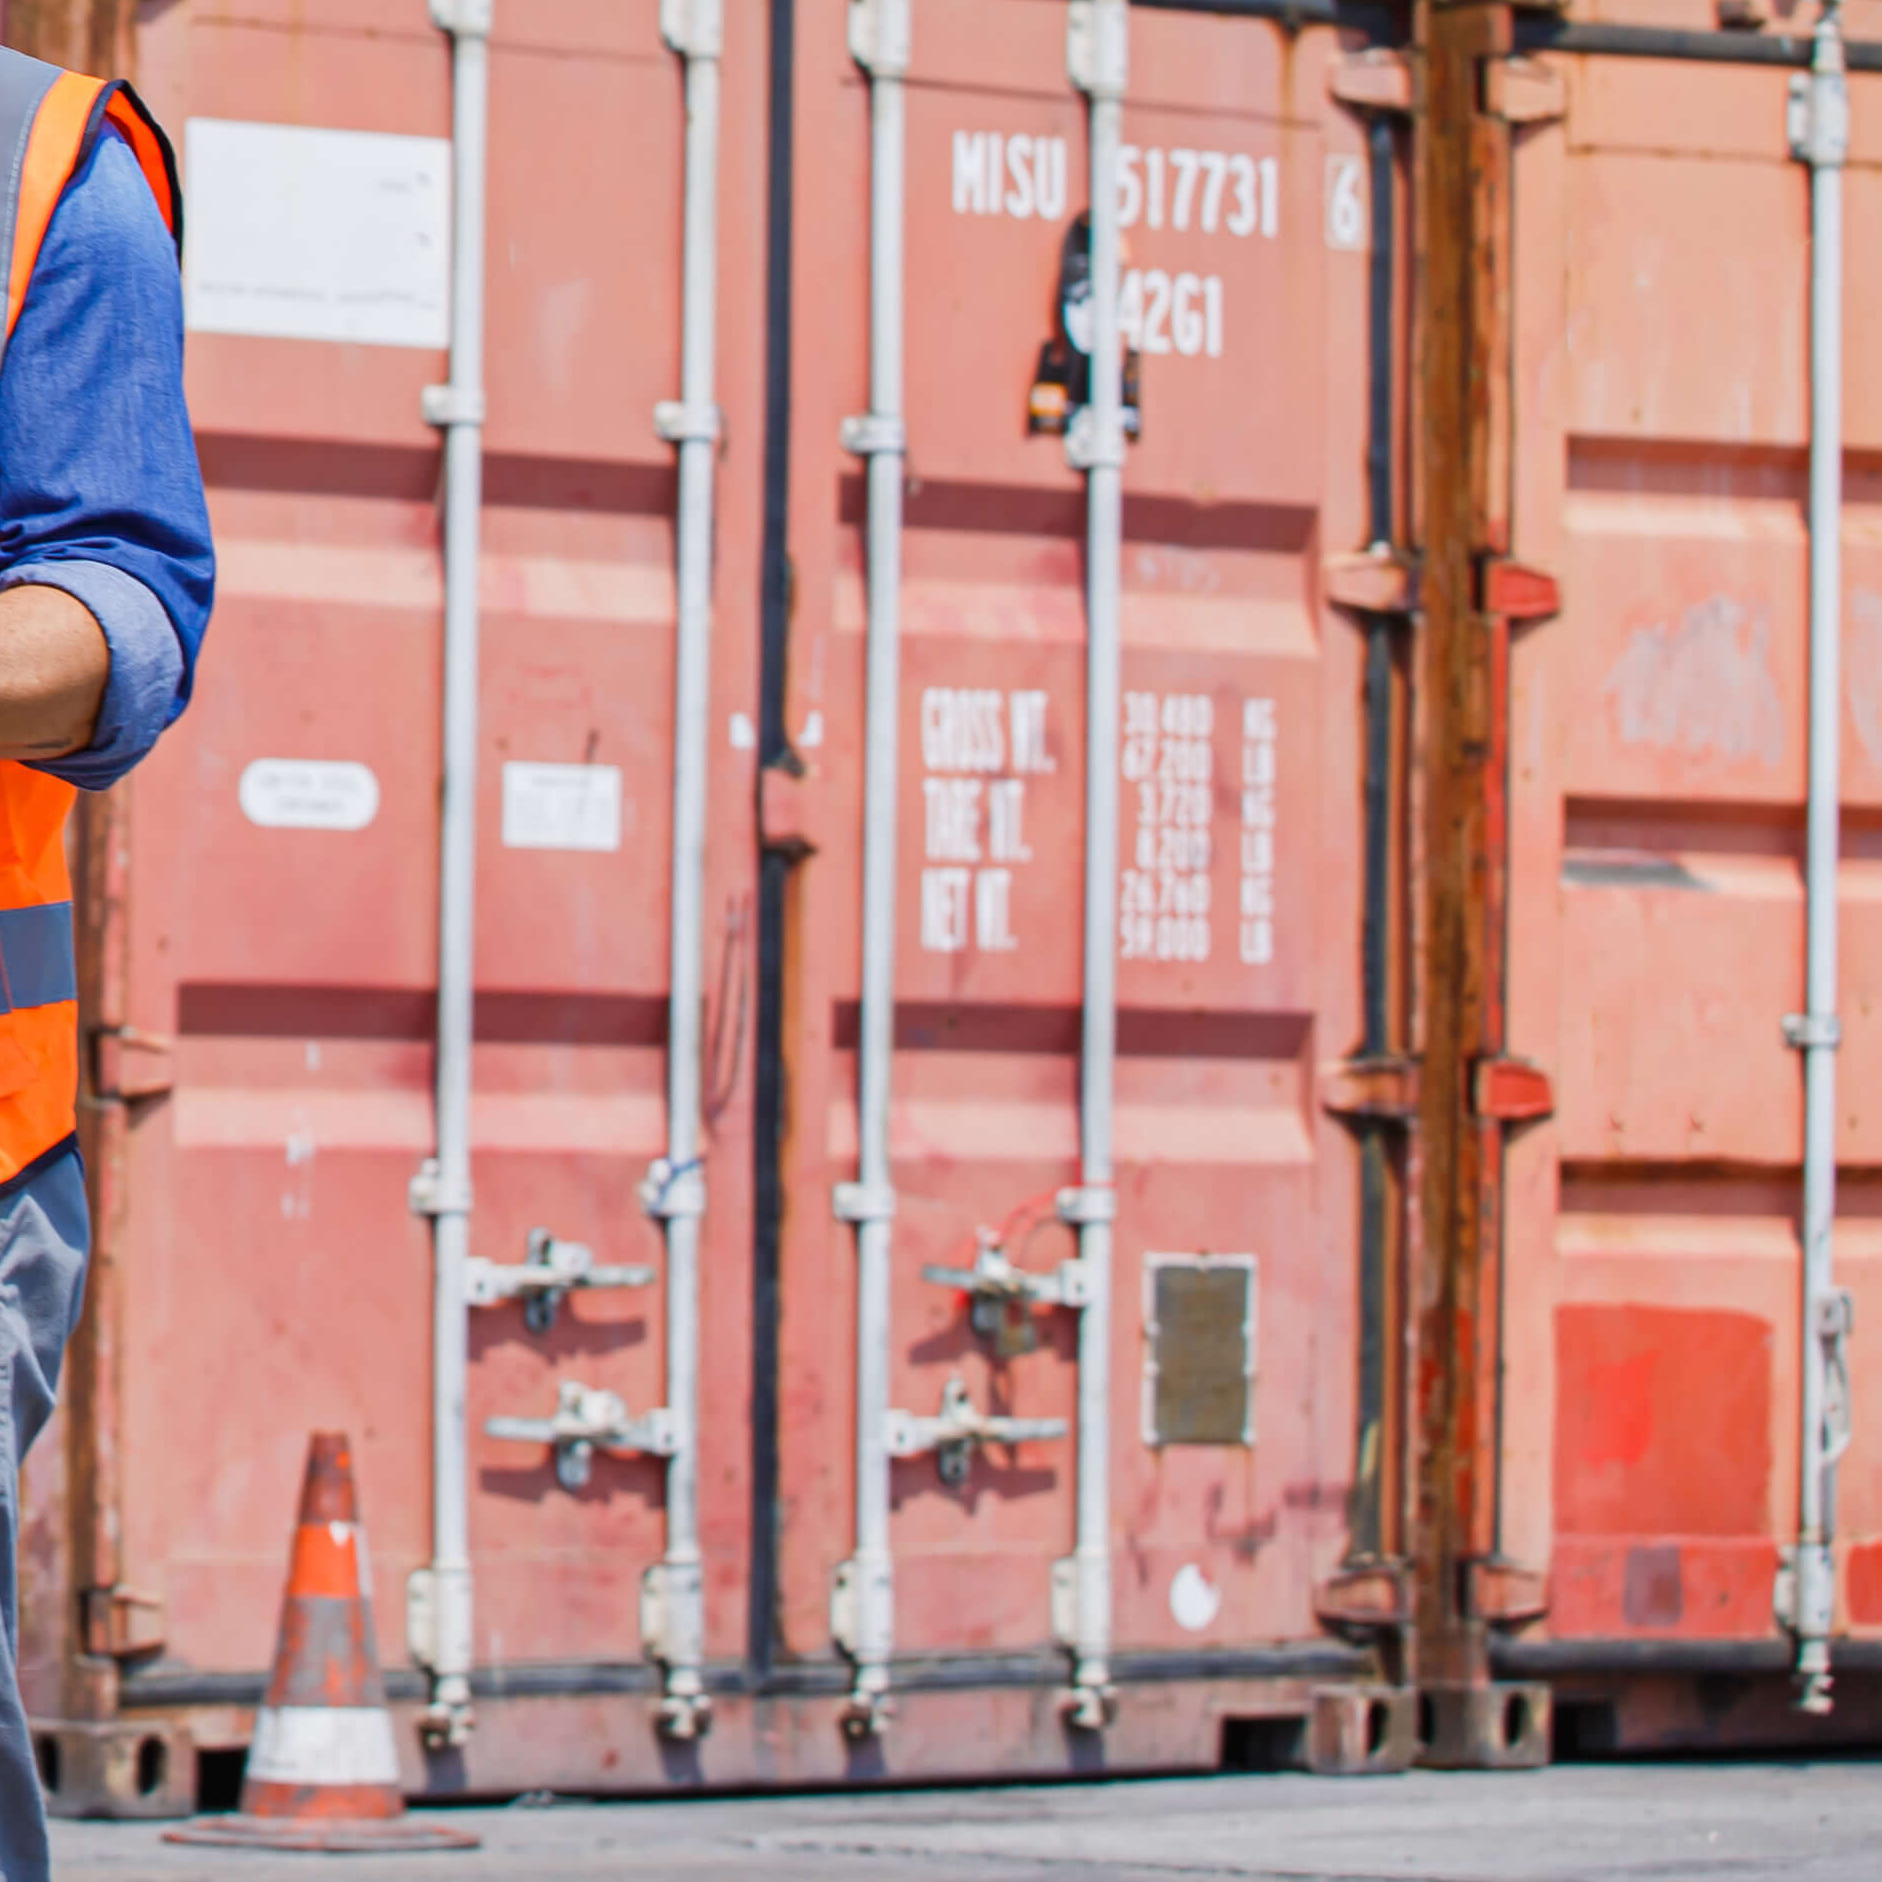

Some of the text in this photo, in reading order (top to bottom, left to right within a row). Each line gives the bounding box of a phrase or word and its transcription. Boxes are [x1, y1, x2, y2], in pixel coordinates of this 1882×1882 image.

[952, 130, 1362, 243] MISU 517731 6
